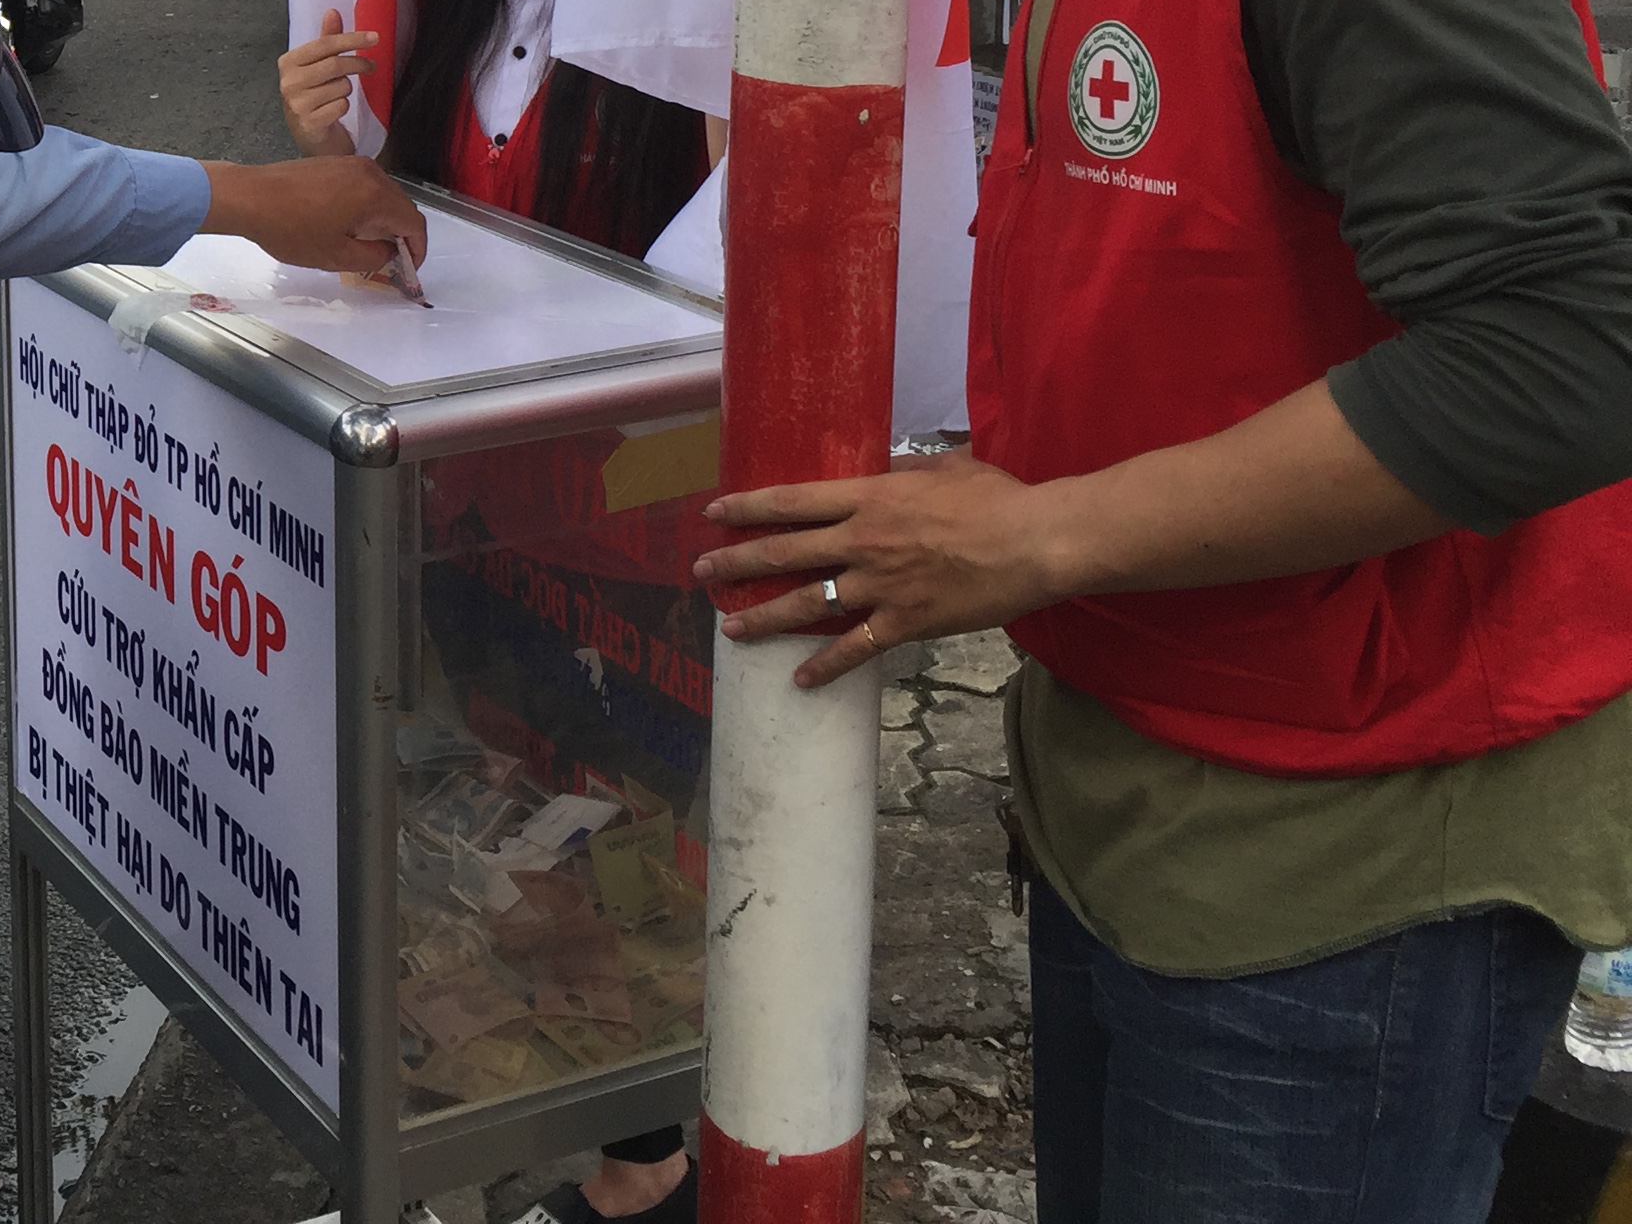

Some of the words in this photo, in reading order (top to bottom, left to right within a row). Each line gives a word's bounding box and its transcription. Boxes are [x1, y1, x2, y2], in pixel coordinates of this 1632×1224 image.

[1087, 164, 1110, 184] PHỐ
[1112, 167, 1128, 187] HỒ
[1128, 173, 1143, 191] CHÍ
[1144, 178, 1177, 196] MINH
[19, 333, 44, 399] HỘI
[49, 358, 81, 419] CHỮ
[84, 382, 129, 454] THẬP
[134, 404, 159, 473] ĐỎ
[164, 431, 188, 492] TP
[194, 441, 220, 516] HỒ
[228, 479, 263, 546] CHÍ
[269, 499, 325, 589] MINH
[46, 442, 175, 606] QUYÊN
[190, 548, 287, 677] GÓP
[42, 640, 95, 744] ĐỒNG
[100, 699, 144, 785] BÀO
[149, 749, 208, 850] MIỀN
[214, 802, 302, 937] TRUNG
[57, 568, 97, 647] CỨU
[102, 605, 146, 699] TRỢ
[152, 649, 217, 754] KHẨN
[223, 706, 275, 795] CẤP
[29, 725, 48, 800] BỊ
[52, 747, 110, 847] THIỆT
[116, 811, 153, 896] HẠI
[159, 852, 192, 932] DO
[197, 890, 272, 1016] THIÊN
[280, 969, 324, 1068] TAI
